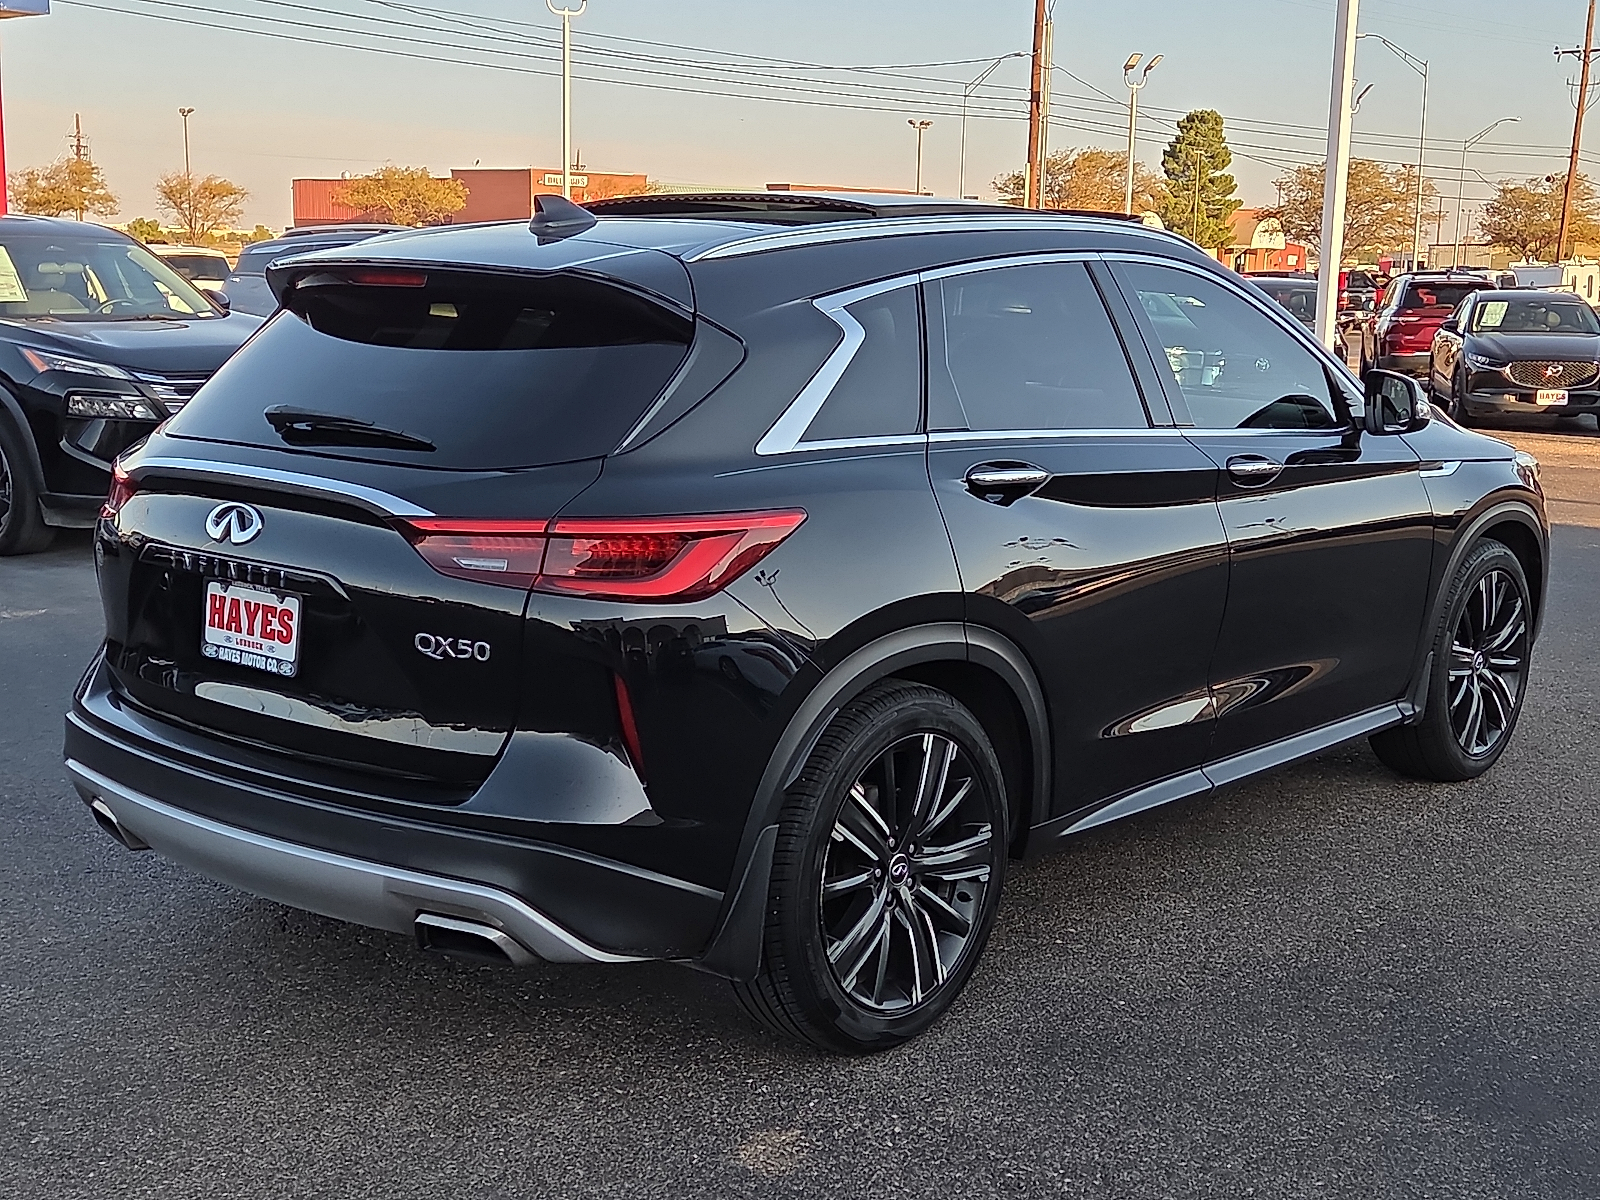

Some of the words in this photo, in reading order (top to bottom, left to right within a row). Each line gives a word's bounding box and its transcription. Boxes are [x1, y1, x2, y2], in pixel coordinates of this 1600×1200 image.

[1539, 392, 1566, 400] HAYES
[208, 593, 293, 645] HAYES
[218, 646, 241, 663] HAYES
[241, 651, 266, 669] MOTOR
[414, 632, 491, 661] QX50
